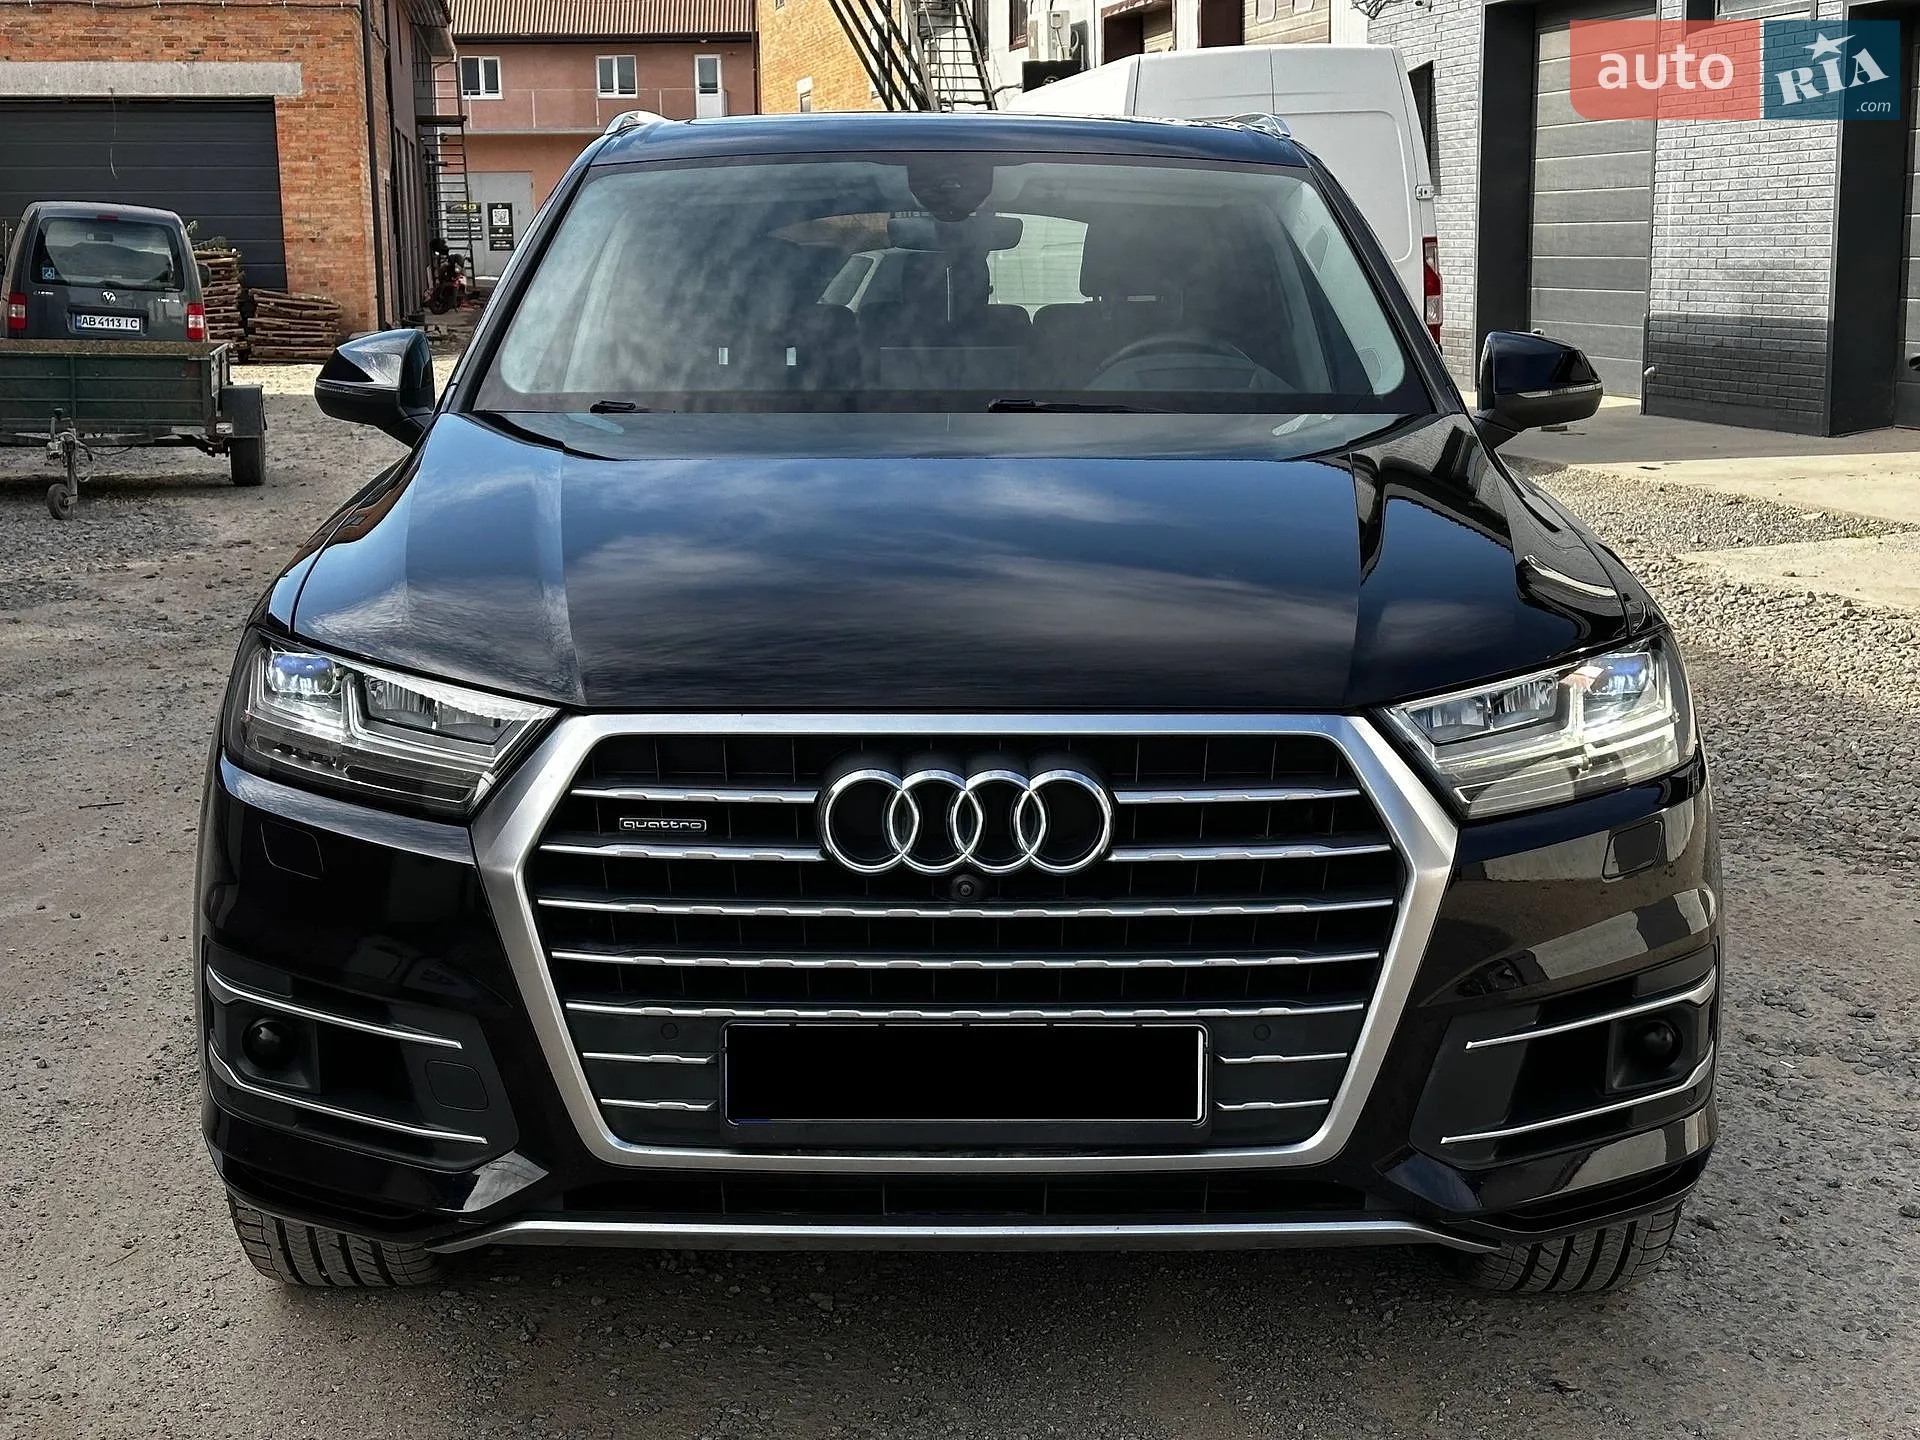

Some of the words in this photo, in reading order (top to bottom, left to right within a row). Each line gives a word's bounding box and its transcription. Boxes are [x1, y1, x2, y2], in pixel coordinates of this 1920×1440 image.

[81, 316, 96, 326] AB
[98, 317, 122, 328] 4113
[125, 318, 138, 329] IC
[623, 820, 702, 829] quattro
